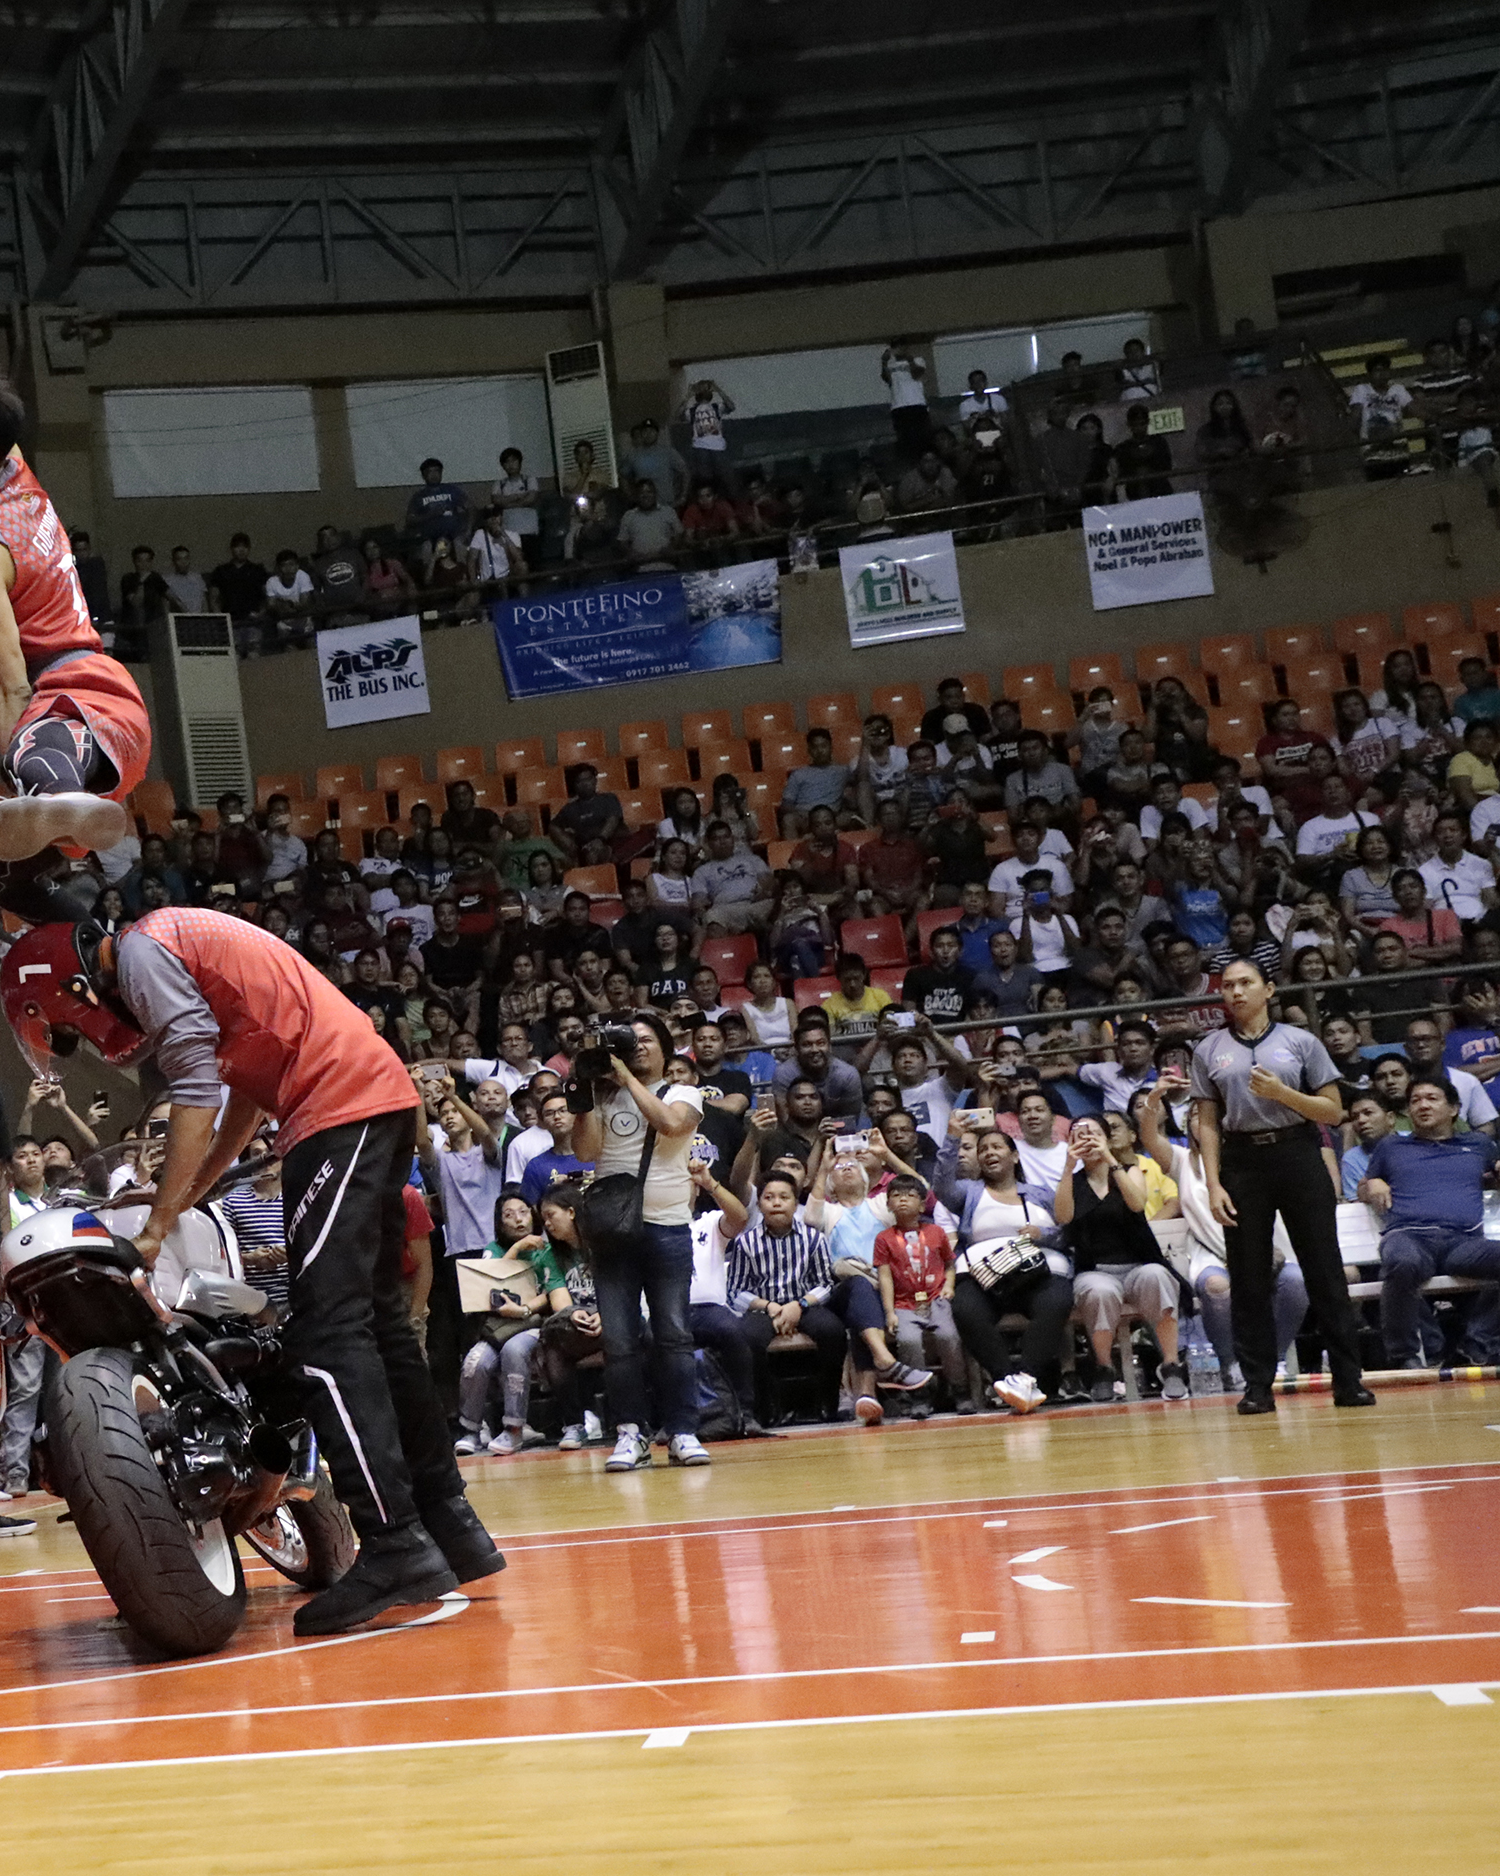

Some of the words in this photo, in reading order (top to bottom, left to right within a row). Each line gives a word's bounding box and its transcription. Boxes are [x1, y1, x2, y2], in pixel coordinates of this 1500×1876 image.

[1153, 412, 1178, 431] EXIT
[1088, 530, 1117, 548] NCA
[1120, 517, 1202, 542] MANPOWER
[1097, 548, 1106, 558] &
[1108, 541, 1149, 557] General
[1151, 536, 1197, 551] Services
[513, 588, 663, 626] PONTEFINO
[529, 610, 644, 637] ESTATES
[325, 643, 418, 680] ALPS
[570, 651, 599, 664] future
[601, 649, 609, 658] is
[626, 667, 647, 678] 0917
[326, 684, 354, 702] THE
[358, 677, 389, 698] BUS
[392, 671, 425, 692] INC.
[651, 980, 687, 997] GAP
[287, 1158, 334, 1245] DAINESE
